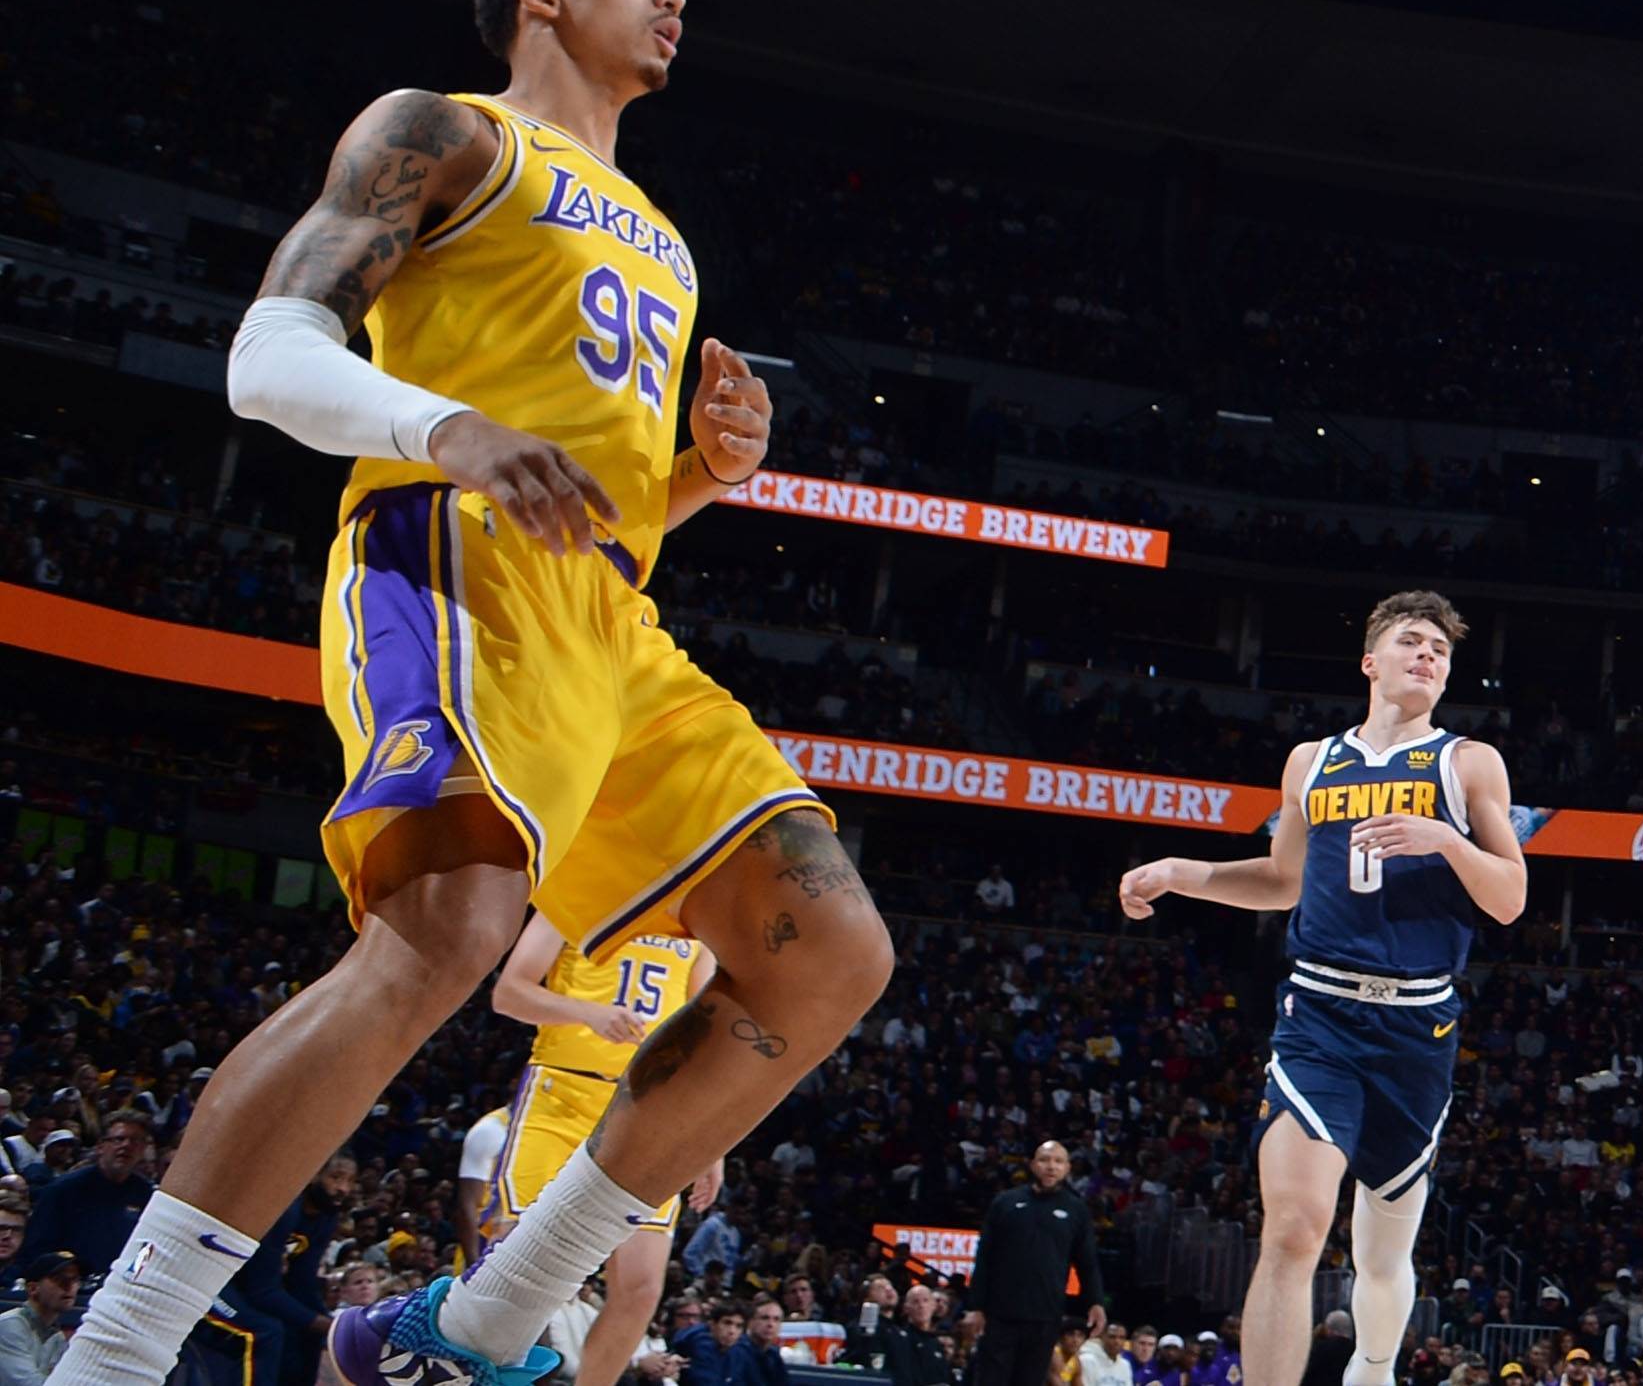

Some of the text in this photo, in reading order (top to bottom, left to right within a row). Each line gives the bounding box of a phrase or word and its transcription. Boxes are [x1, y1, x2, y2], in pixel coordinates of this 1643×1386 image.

[530, 164, 694, 293] LAKERS
[575, 263, 679, 422] 95
[978, 507, 1154, 562] BREWERY
[773, 734, 1232, 826] KENRIDGE BREWERY
[1308, 780, 1437, 826] DENVER
[612, 959, 668, 1020] 15
